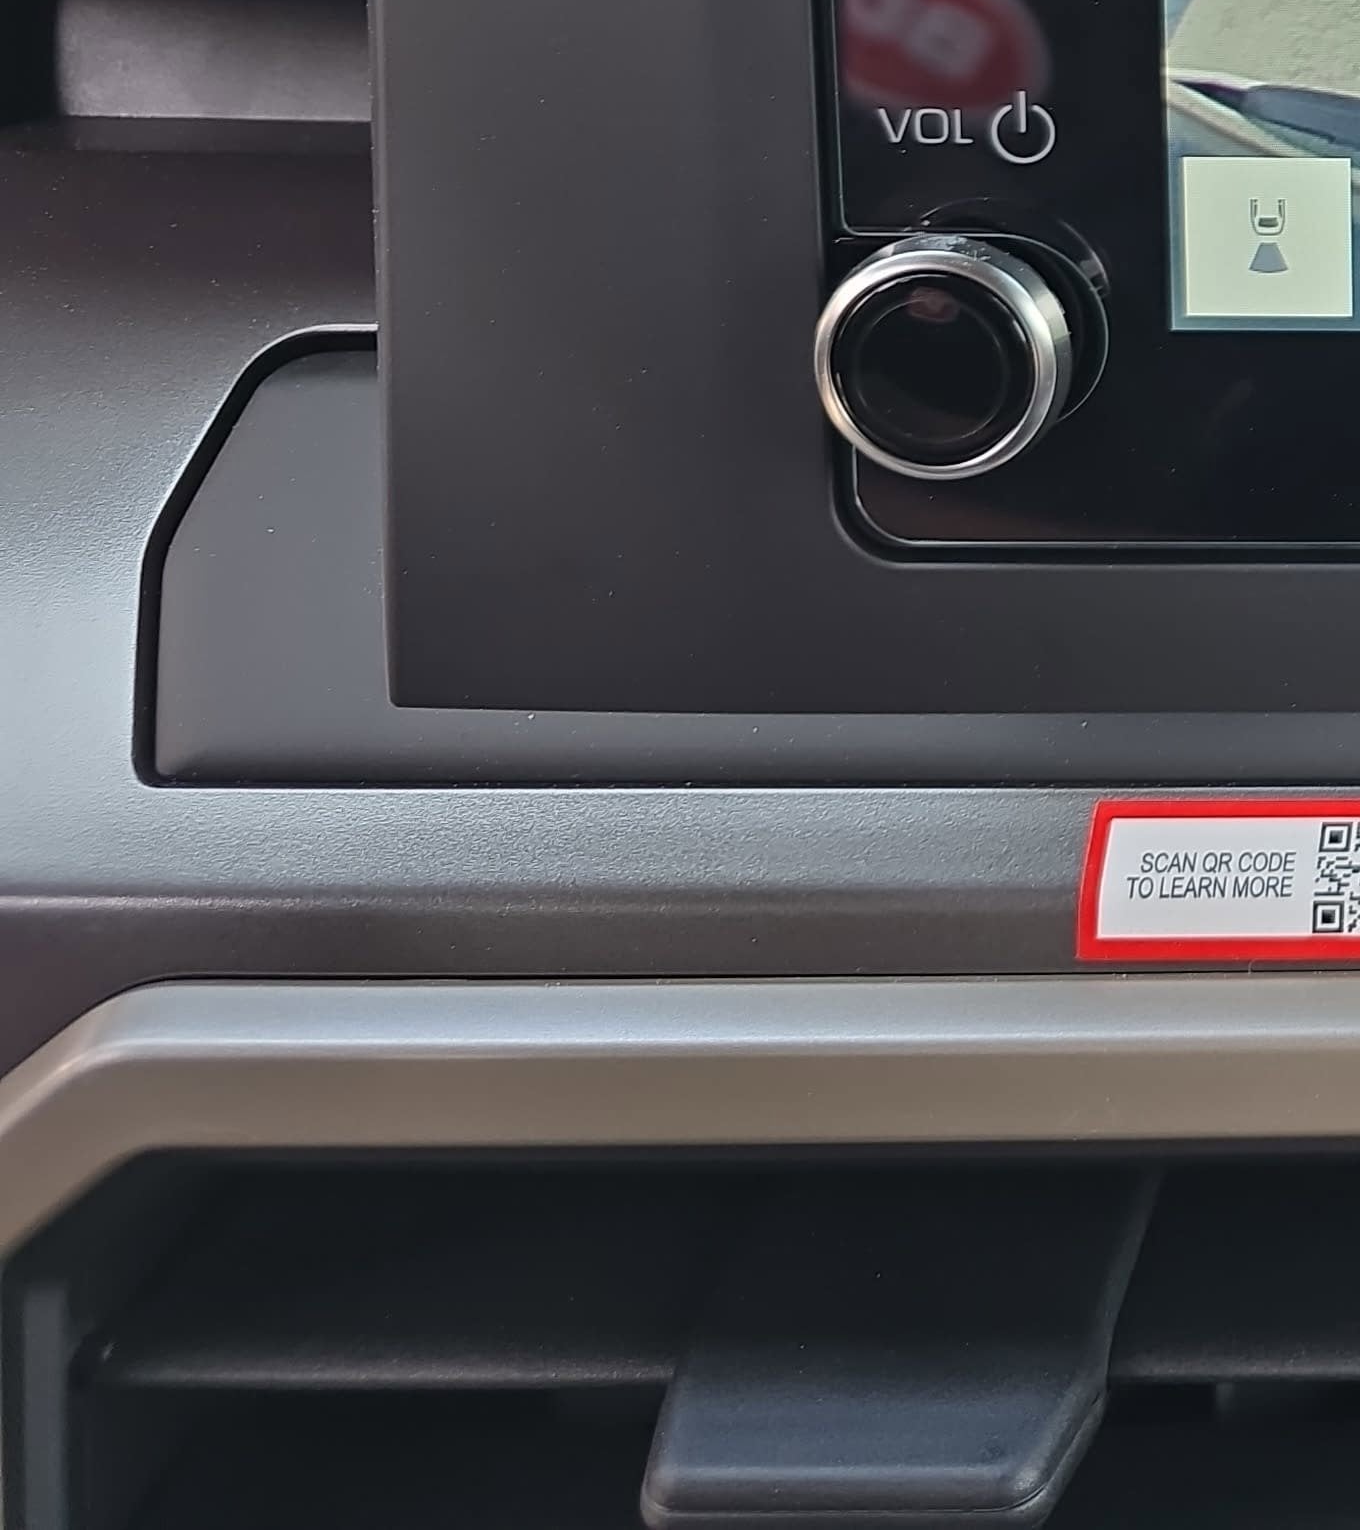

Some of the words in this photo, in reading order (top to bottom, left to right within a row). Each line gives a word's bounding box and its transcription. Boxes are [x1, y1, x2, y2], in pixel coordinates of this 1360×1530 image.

[877, 108, 974, 144] VOL
[1141, 852, 1198, 875] SCAN
[1202, 852, 1234, 874] QR
[1238, 851, 1297, 874] CODE
[1127, 876, 1155, 900] TO
[1159, 876, 1229, 899] LEARN
[1233, 875, 1295, 898] MORE
